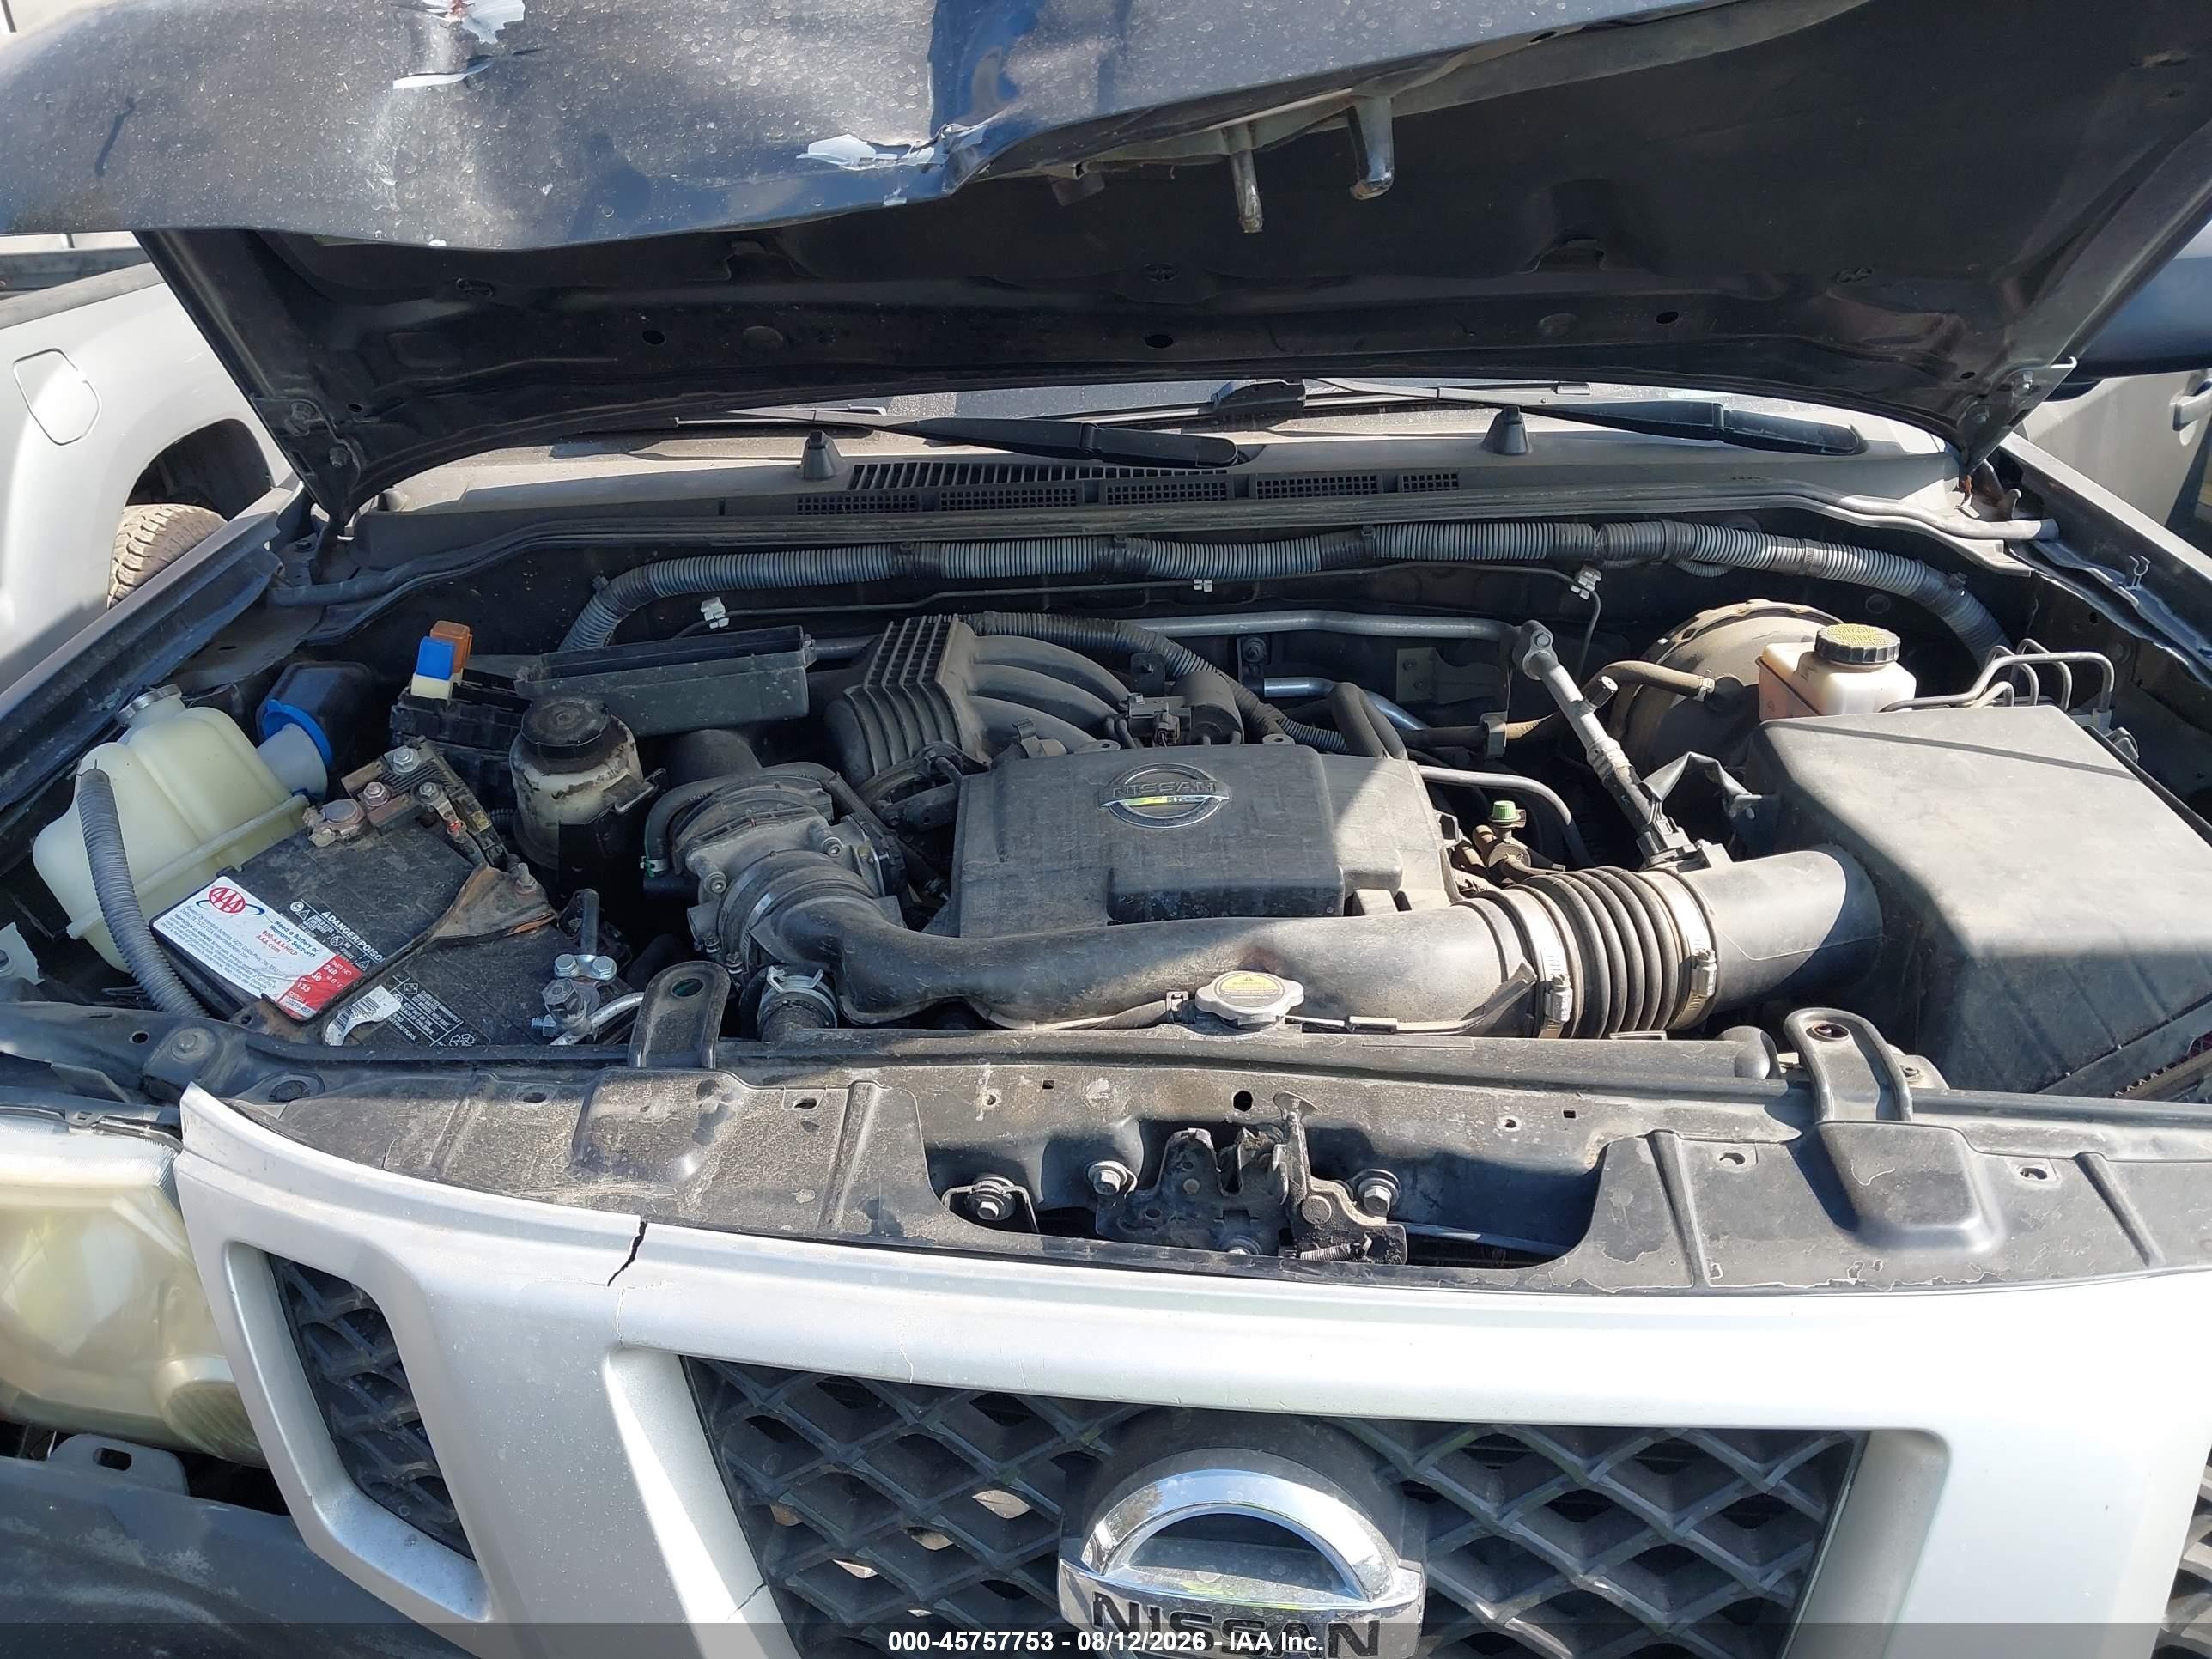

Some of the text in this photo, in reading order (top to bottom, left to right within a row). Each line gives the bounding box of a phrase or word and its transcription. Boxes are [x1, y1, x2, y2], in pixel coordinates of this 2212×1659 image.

[1113, 781, 1217, 798] NISSAN
[210, 888, 246, 913] AAA
[255, 935, 281, 953] AAA.com
[262, 930, 298, 956] 800-AAA-HELP
[270, 925, 291, 942] Warranty
[291, 941, 315, 957] Support?
[275, 921, 289, 932] Need
[294, 933, 311, 948] Battery
[323, 965, 337, 975] 24R
[1092, 1591, 1380, 1659] NISSAN
